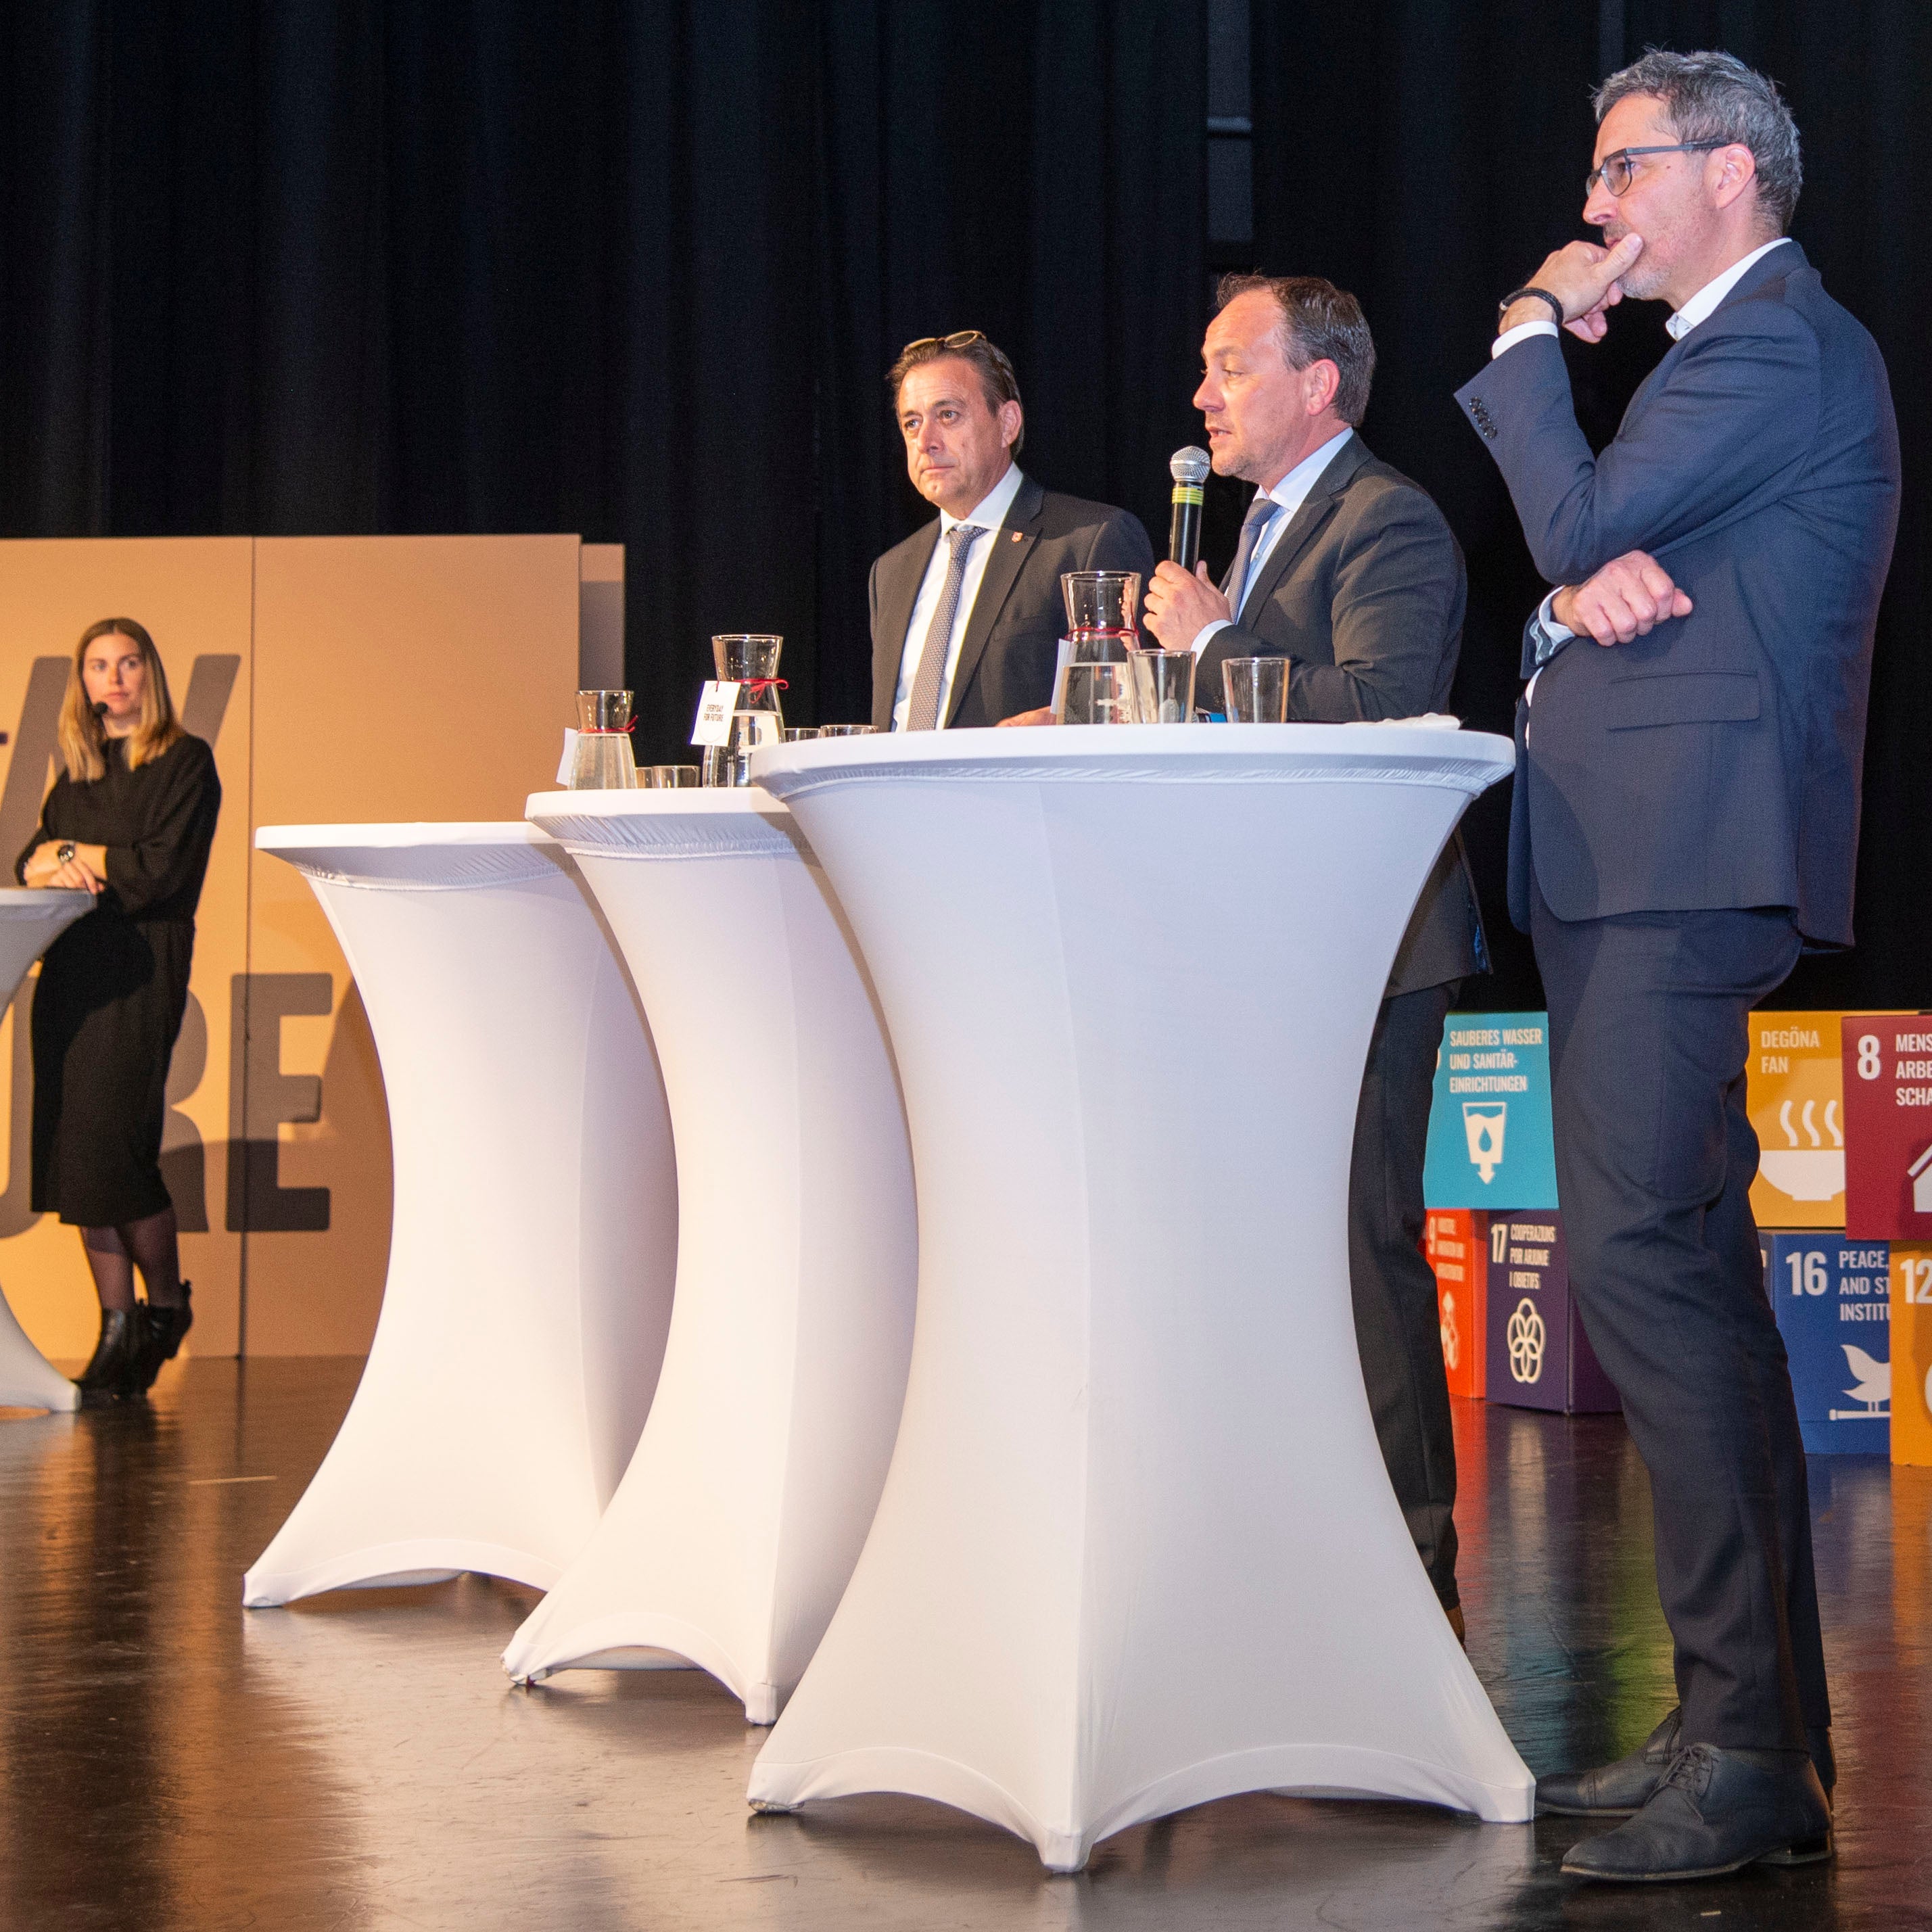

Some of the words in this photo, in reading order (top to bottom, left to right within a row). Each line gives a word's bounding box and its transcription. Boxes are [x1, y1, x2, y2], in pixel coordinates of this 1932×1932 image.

[1450, 1030, 1500, 1047] SAUBERES
[1503, 1029, 1542, 1045] WASSER
[1761, 1027, 1820, 1048] DEGÖNA
[1895, 1034, 1932, 1052] MENS
[1450, 1053, 1470, 1070] UND
[1474, 1050, 1517, 1068] SANITÄR-
[1761, 1056, 1789, 1074] FAN
[1858, 1035, 1881, 1080] 8
[1450, 1076, 1528, 1093] EINRICHTUNGEN
[1491, 1223, 1508, 1263] 17
[1786, 1251, 1827, 1296] 16
[1900, 1258, 1932, 1304] 12
[1839, 1277, 1870, 1295] AND
